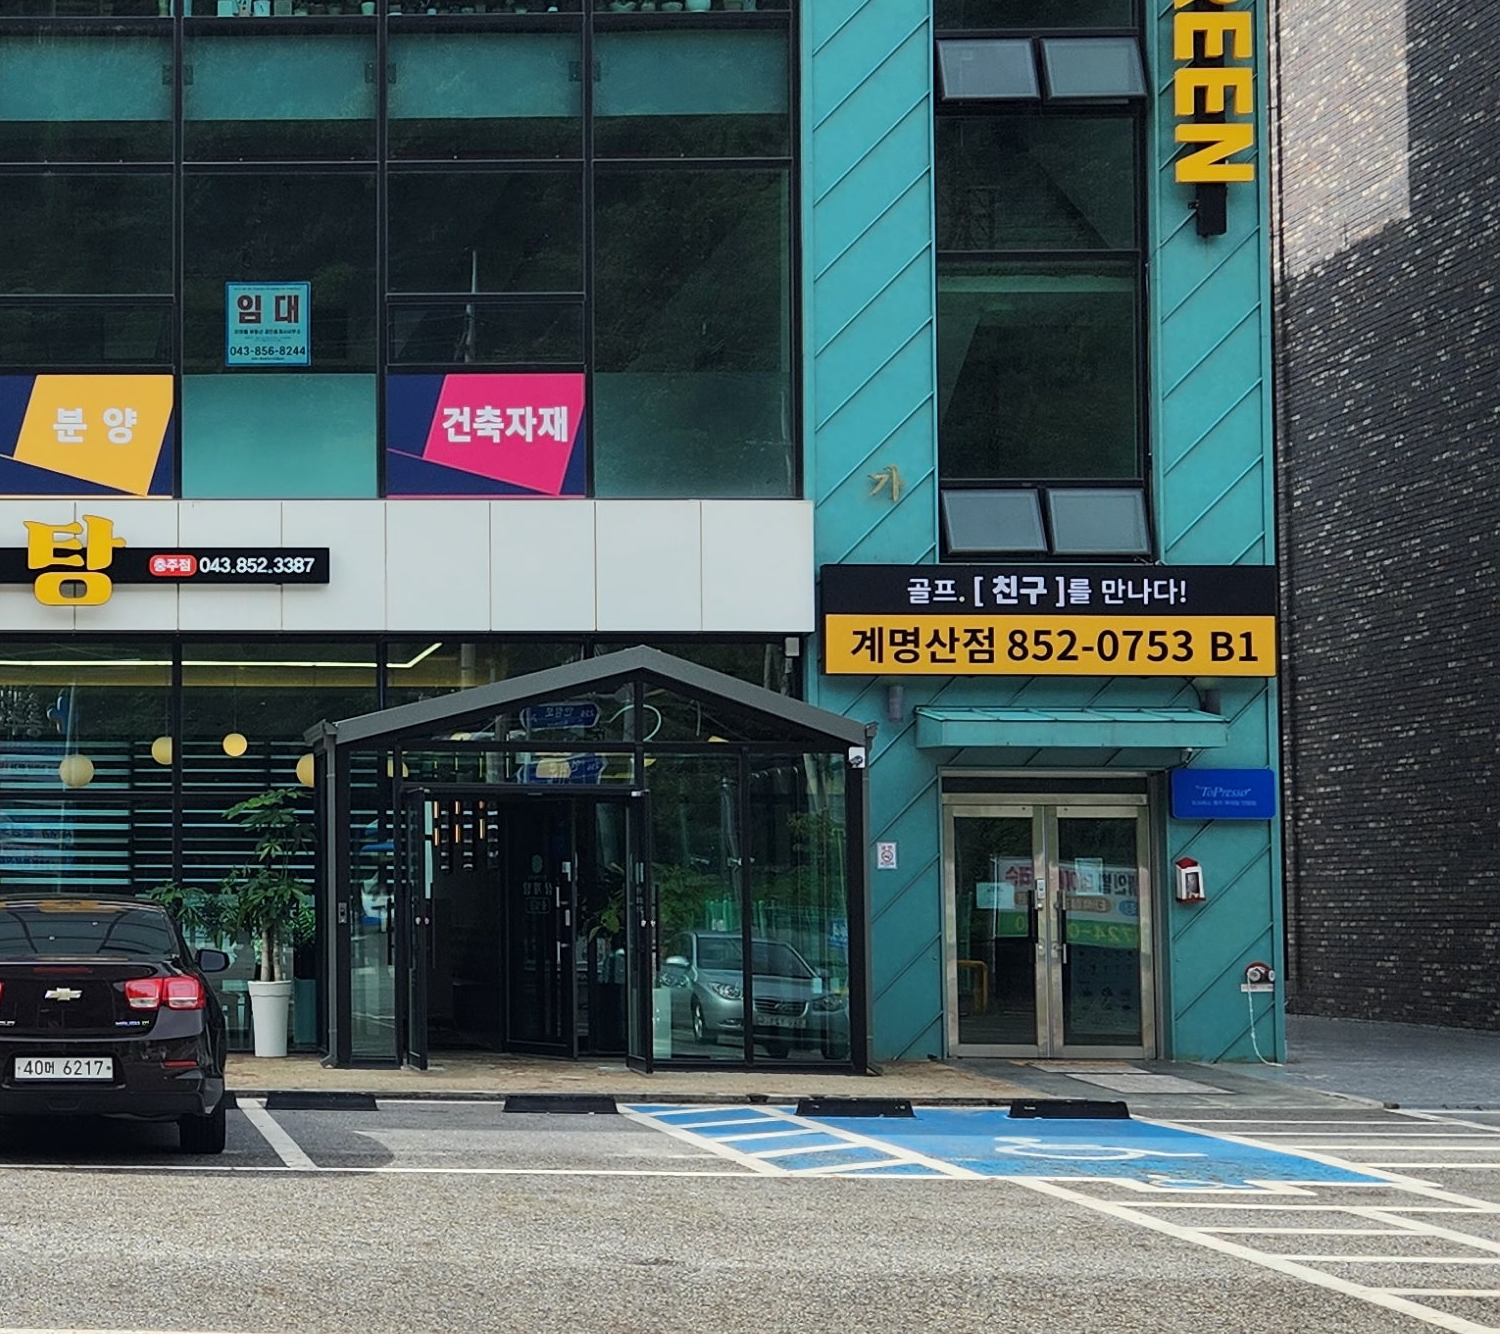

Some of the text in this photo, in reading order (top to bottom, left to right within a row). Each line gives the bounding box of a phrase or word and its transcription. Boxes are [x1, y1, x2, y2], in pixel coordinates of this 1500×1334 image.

[229, 346, 307, 357] 043-856-8244
[441, 405, 569, 443] 건축자재
[199, 556, 316, 574] 043.852.3387
[1101, 577, 1188, 605] 만나다!
[850, 626, 1260, 665] 계명산점 852-0753 B1
[62, 1059, 104, 1076] 6217
